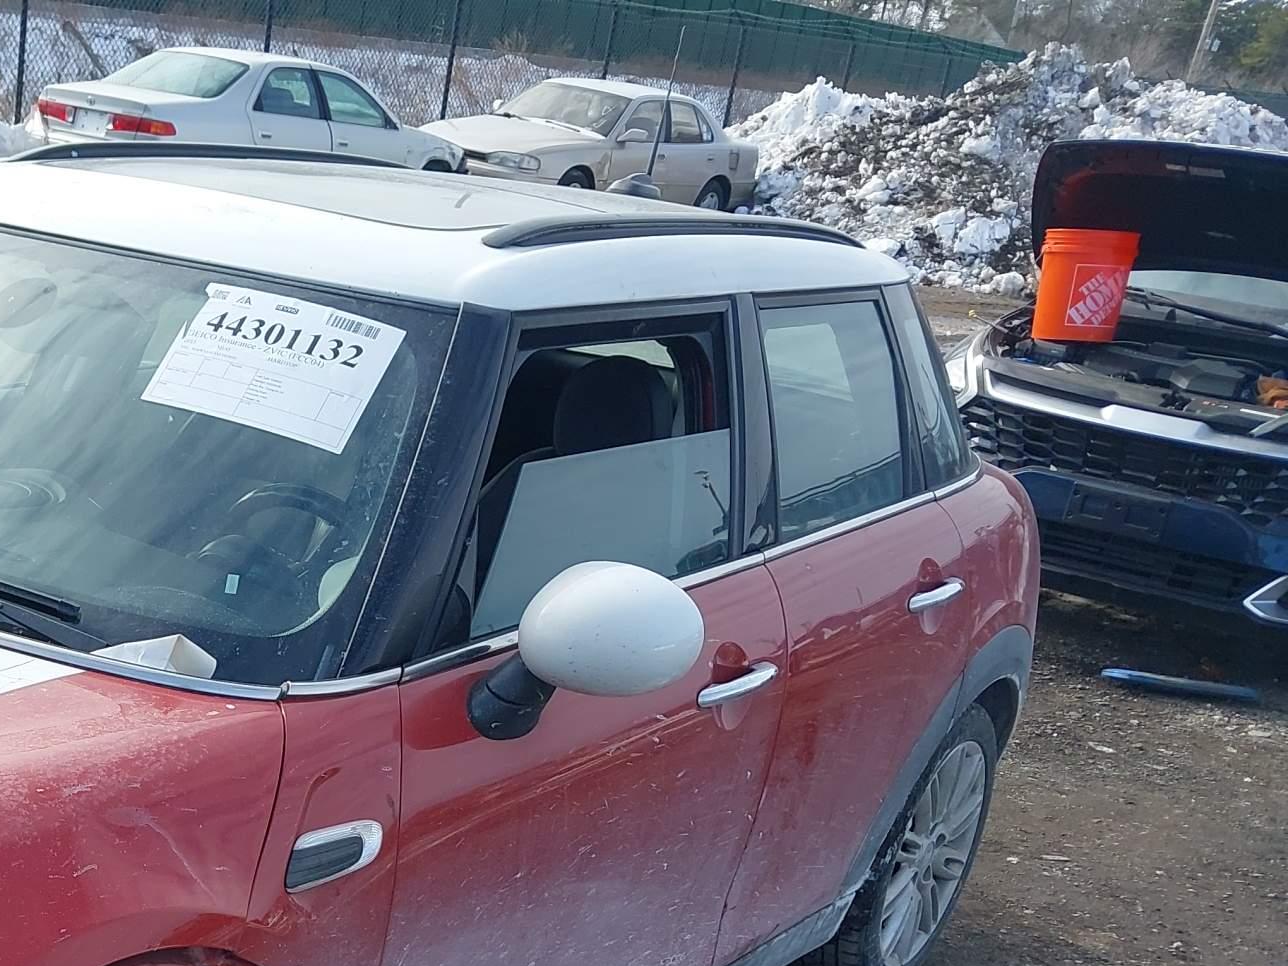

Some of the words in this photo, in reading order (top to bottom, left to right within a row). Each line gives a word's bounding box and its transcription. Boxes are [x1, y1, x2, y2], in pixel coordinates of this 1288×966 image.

[1078, 271, 1106, 296] THE
[206, 311, 364, 369] 44301132
[218, 335, 257, 350] Insurance
